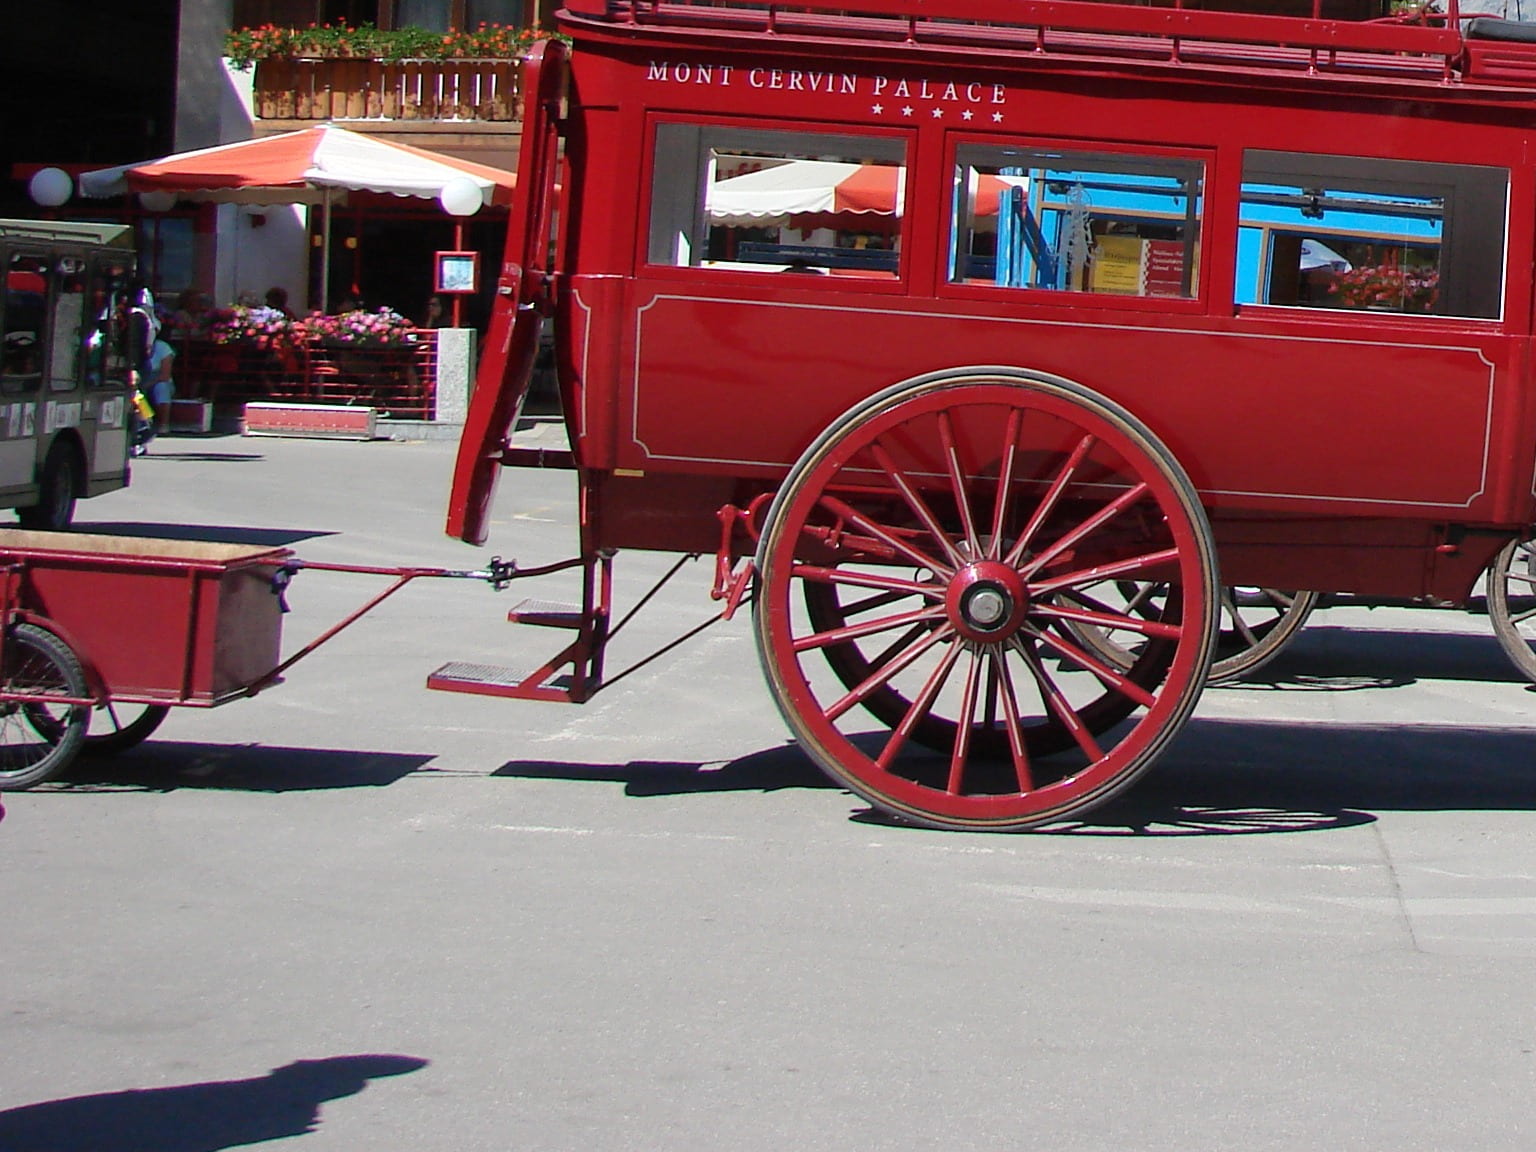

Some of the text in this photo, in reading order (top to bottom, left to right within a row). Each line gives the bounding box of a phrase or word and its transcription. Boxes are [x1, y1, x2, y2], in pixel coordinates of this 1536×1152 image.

[647, 60, 1007, 104] MONT CERVIN PALACE
